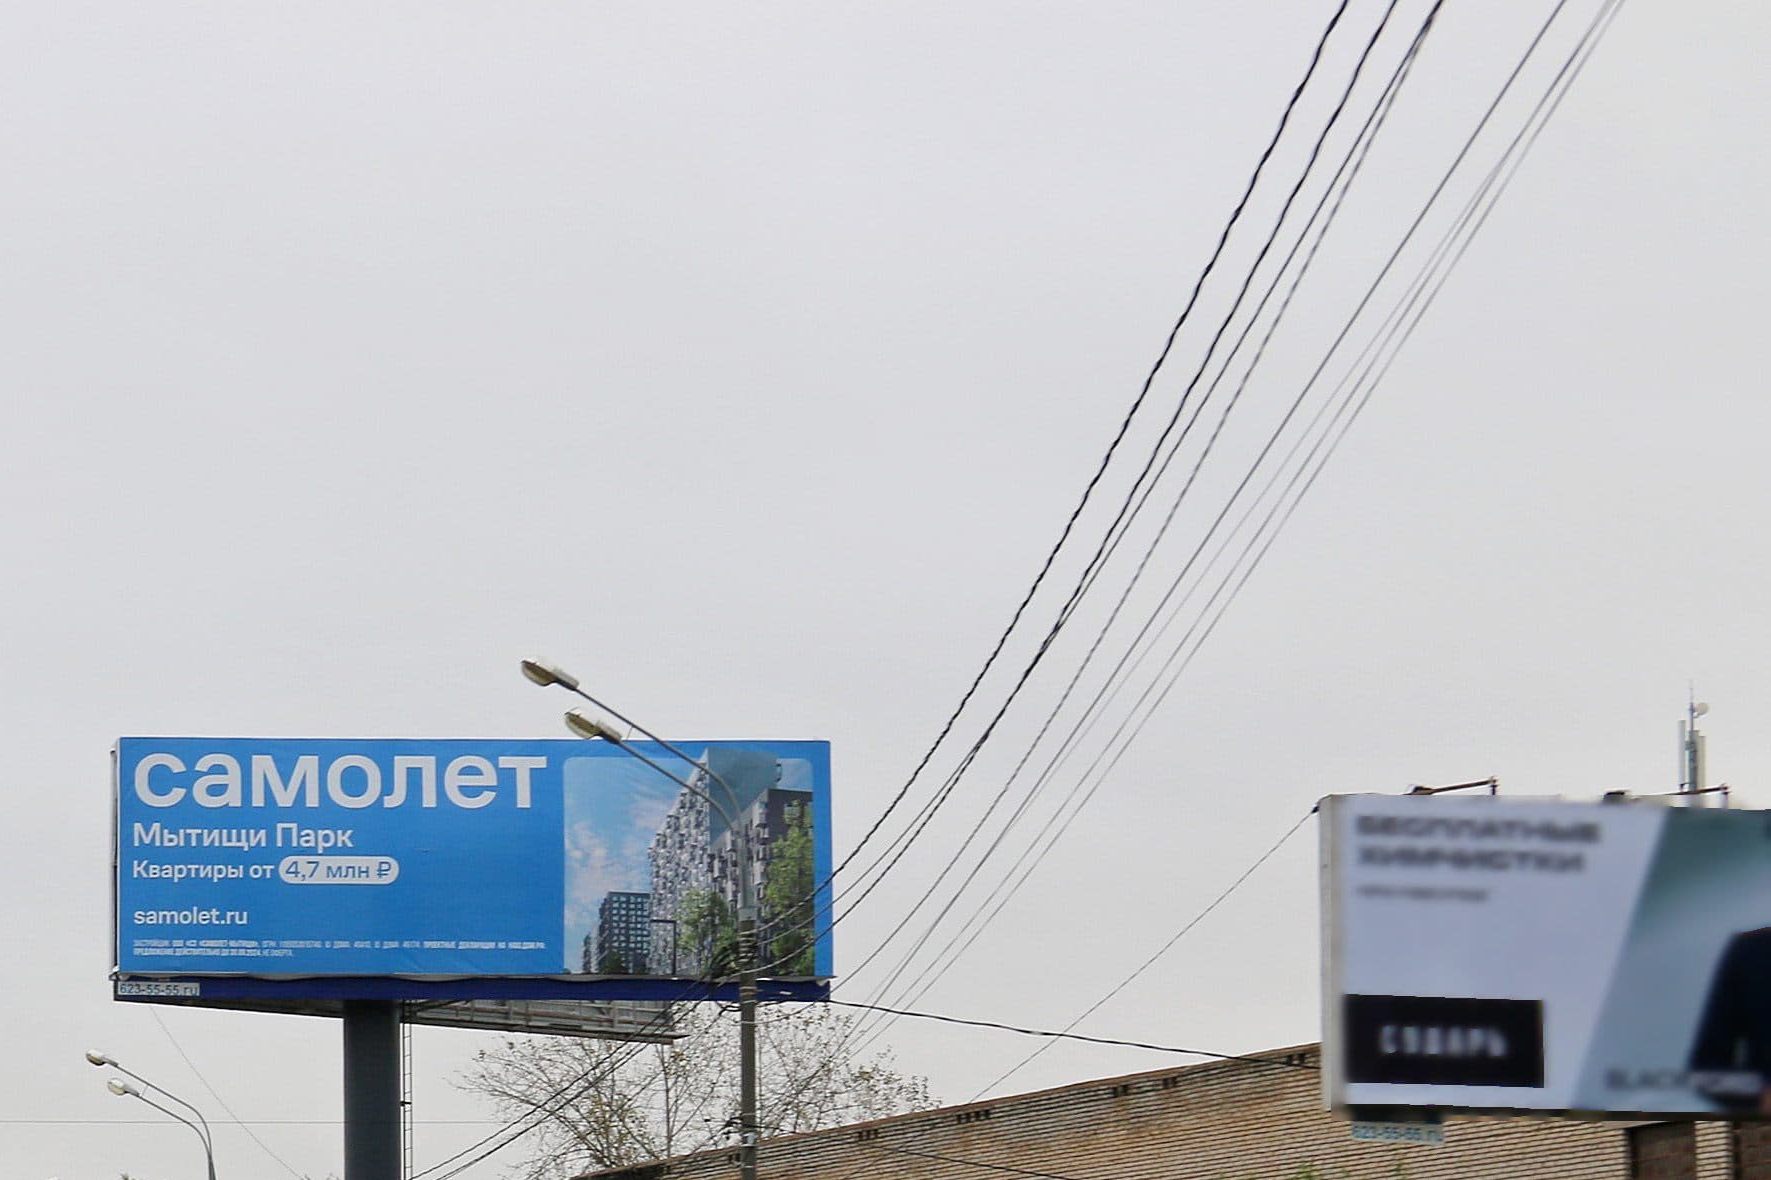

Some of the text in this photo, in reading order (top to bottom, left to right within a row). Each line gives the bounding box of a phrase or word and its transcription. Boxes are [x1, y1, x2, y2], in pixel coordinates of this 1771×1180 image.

[133, 752, 547, 809] самолет
[132, 822, 354, 854] Мытищи Парк
[132, 860, 245, 883] Квартиры
[249, 862, 275, 879] от
[285, 861, 320, 882] 4,7
[325, 863, 370, 879] млн
[133, 906, 248, 926] samolet.ru
